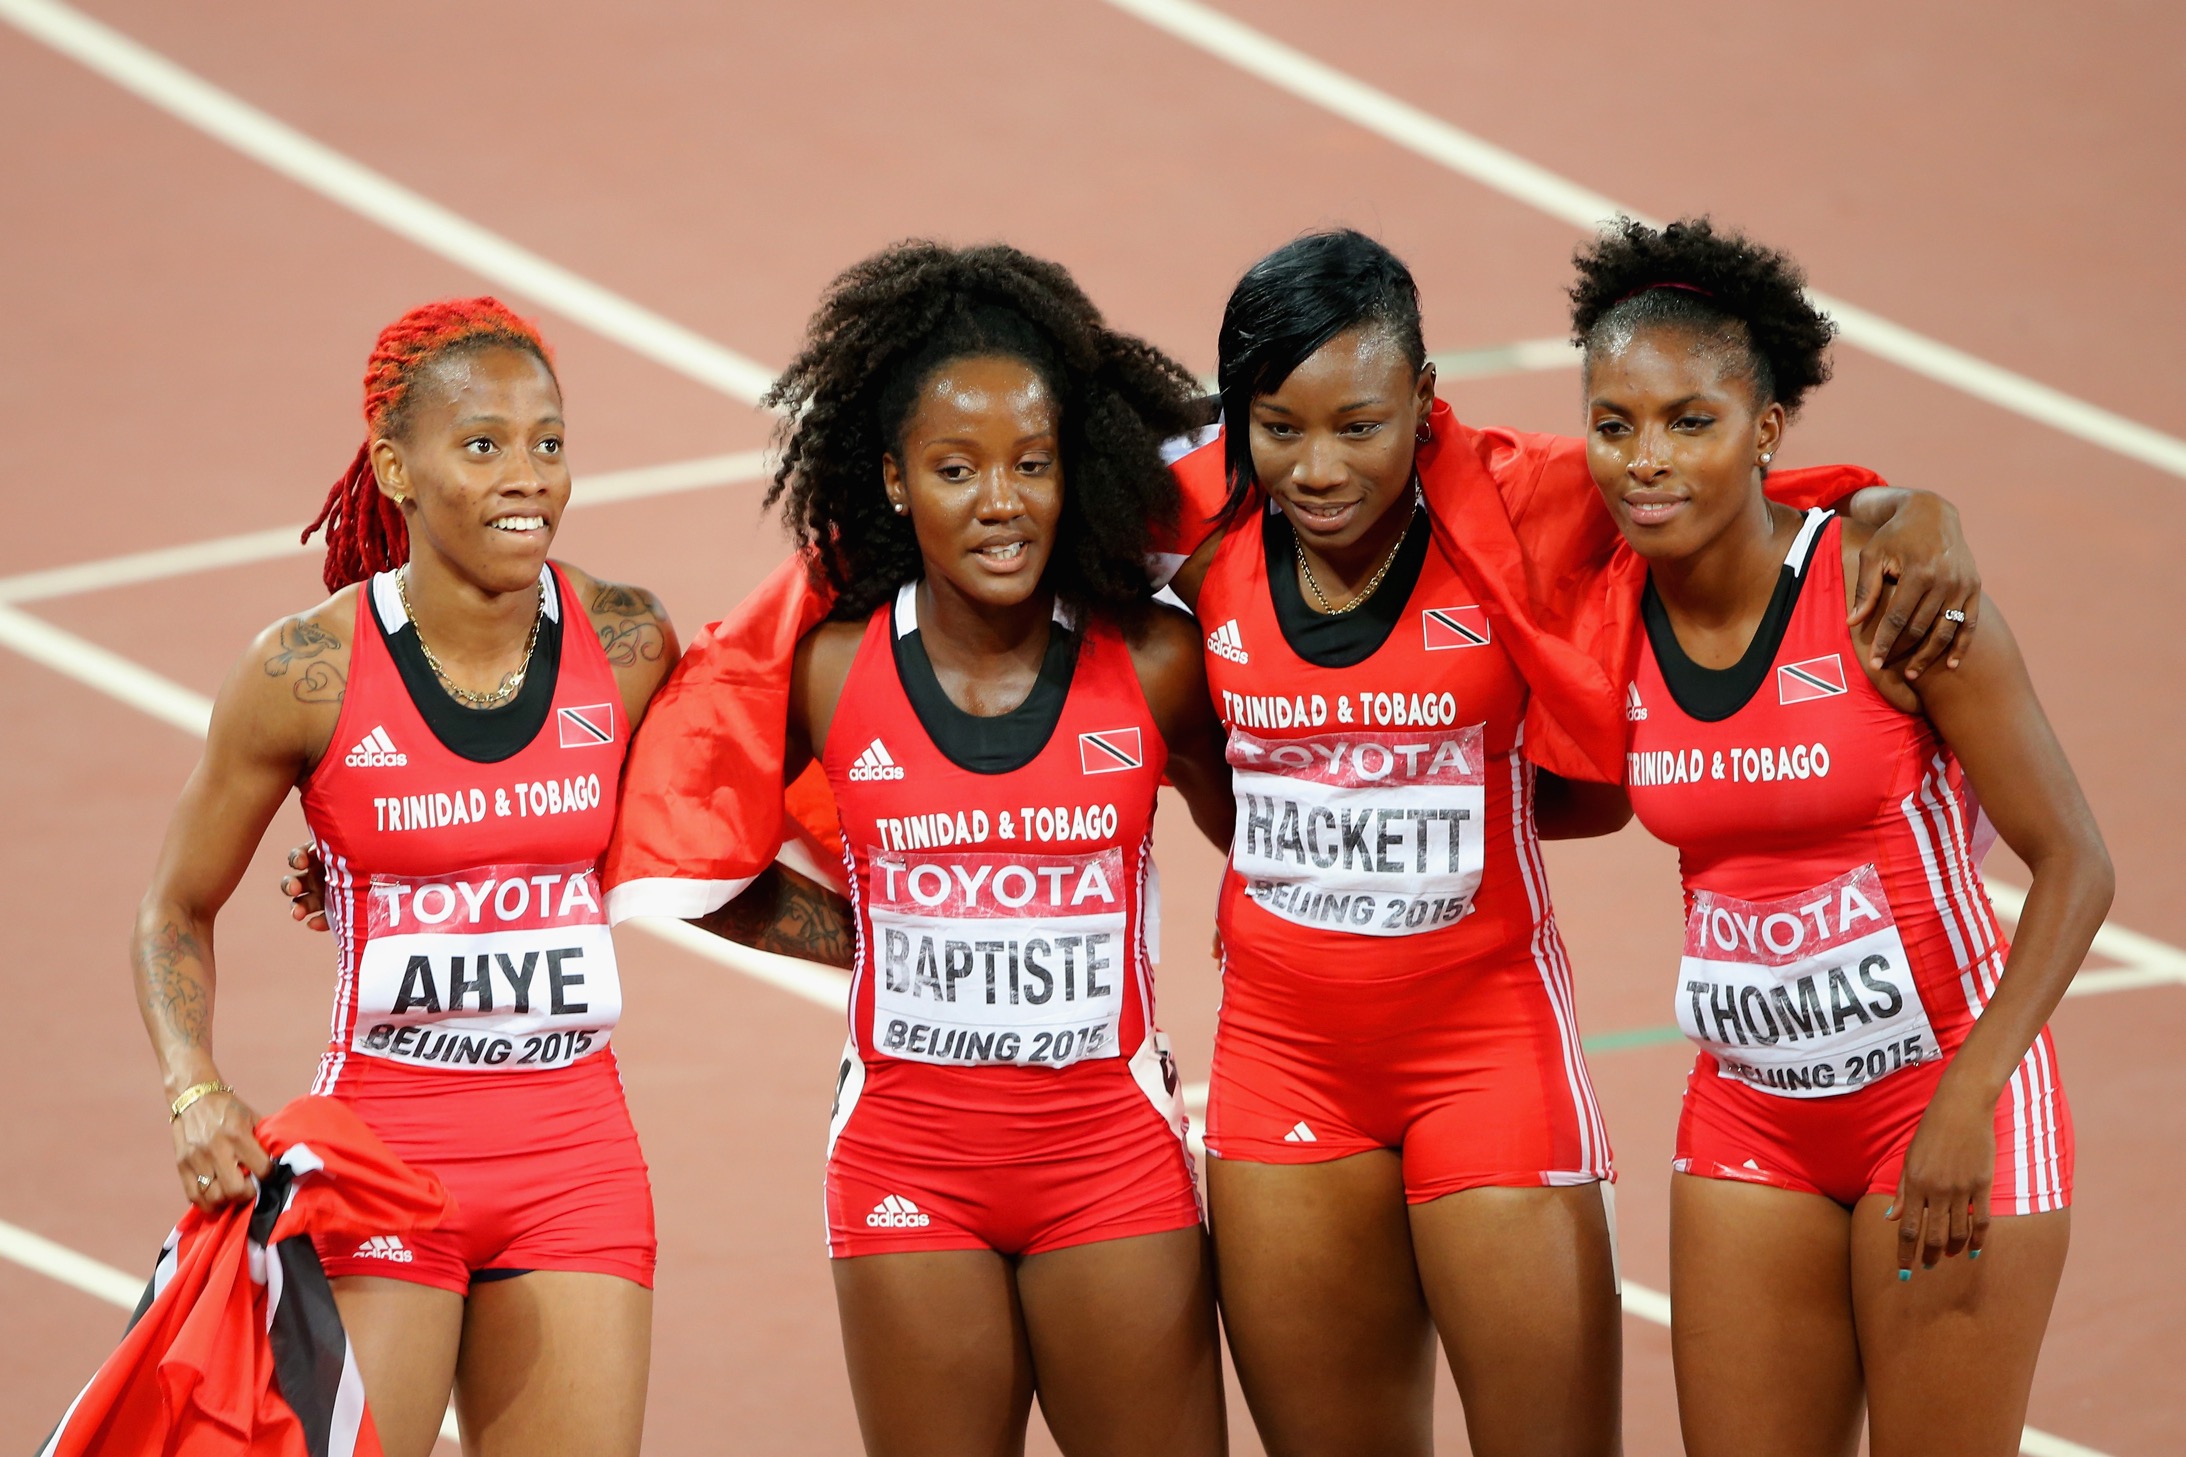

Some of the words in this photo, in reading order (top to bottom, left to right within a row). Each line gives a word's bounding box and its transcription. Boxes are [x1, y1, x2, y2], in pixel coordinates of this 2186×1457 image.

[1207, 638, 1249, 665] adidas
[1222, 689, 1327, 728] TRINIDAD
[1337, 695, 1353, 723] &
[1360, 692, 1456, 726] TOBAGO
[345, 751, 407, 768] adidas
[848, 764, 905, 782] adidas
[1233, 740, 1472, 781] TOYOTA
[1627, 748, 1705, 786] TRINIDAD
[1711, 751, 1726, 780] &
[1731, 742, 1830, 783] TOBAGO
[374, 788, 487, 832] TRINIDAD
[495, 789, 511, 817] &
[515, 773, 601, 817] TOBAGO
[876, 809, 990, 852] TRINIDAD
[999, 812, 1015, 840] &
[1020, 803, 1119, 843] TOBAGO
[1246, 793, 1471, 873] HACKETT
[373, 871, 600, 928] TOYOTA
[876, 859, 1116, 909] TOYOTA
[1254, 879, 1376, 928] BEIJING
[1381, 897, 1465, 929] 2015
[1693, 884, 1882, 956] TOYOTA
[390, 946, 590, 1017] AHYE
[885, 928, 1112, 1006] BAPTISTE
[1686, 953, 1904, 1047] THOMAS
[366, 1024, 512, 1066] BEIJING
[516, 1029, 599, 1066] 2015
[883, 1019, 1021, 1064] BEIJING
[1027, 1023, 1109, 1062] 2015
[1844, 1034, 1924, 1087] 2015
[866, 1212, 930, 1227] adidas
[352, 1247, 413, 1263] adidas
